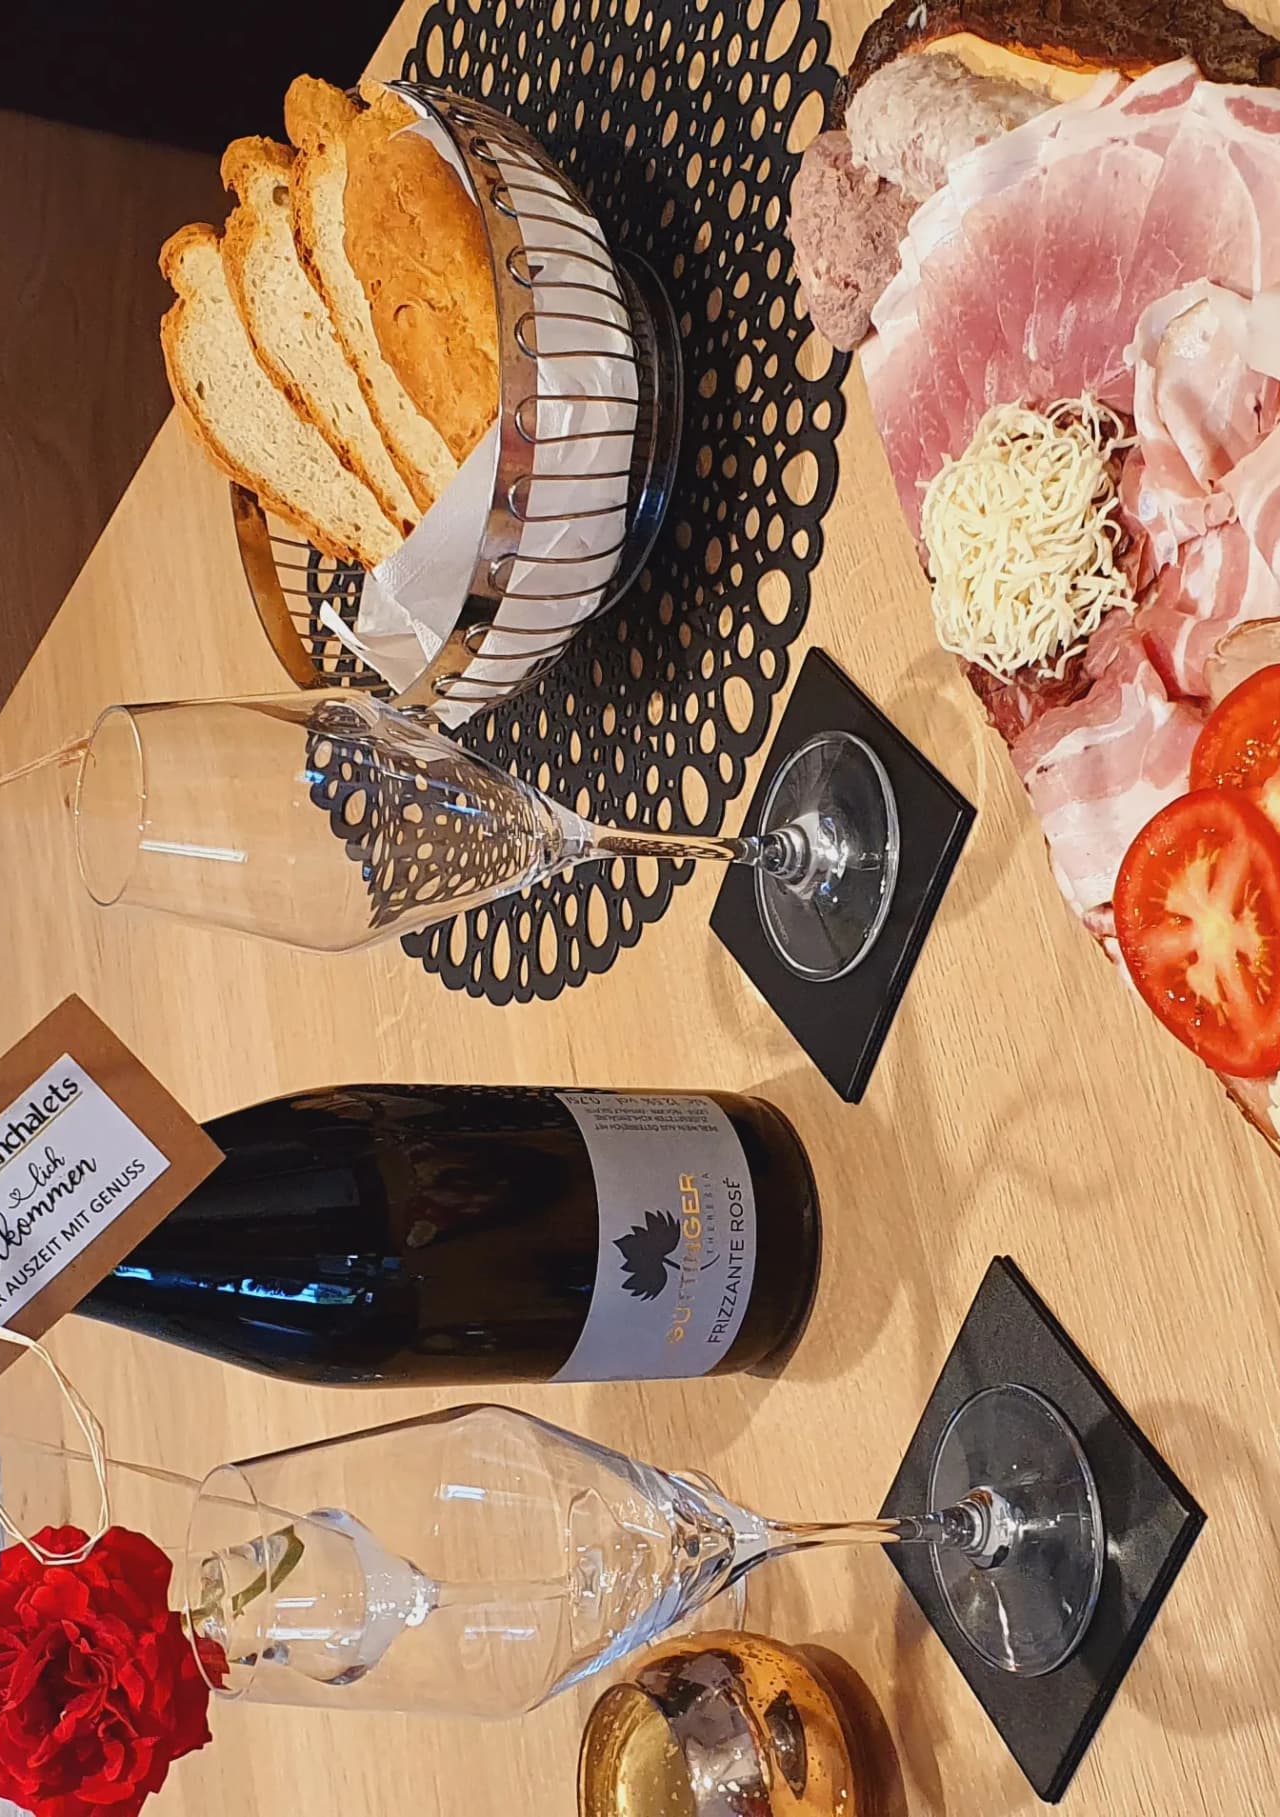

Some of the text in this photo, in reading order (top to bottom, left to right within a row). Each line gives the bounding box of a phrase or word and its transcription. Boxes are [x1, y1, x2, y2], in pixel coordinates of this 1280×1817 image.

[5, 1236, 62, 1296] AUSZEIT
[60, 1209, 91, 1242] MIT
[89, 1158, 146, 1214] GENUSS
[22, 1145, 66, 1193] lich
[707, 1177, 745, 1343] FRIZZANTE ROSÉ
